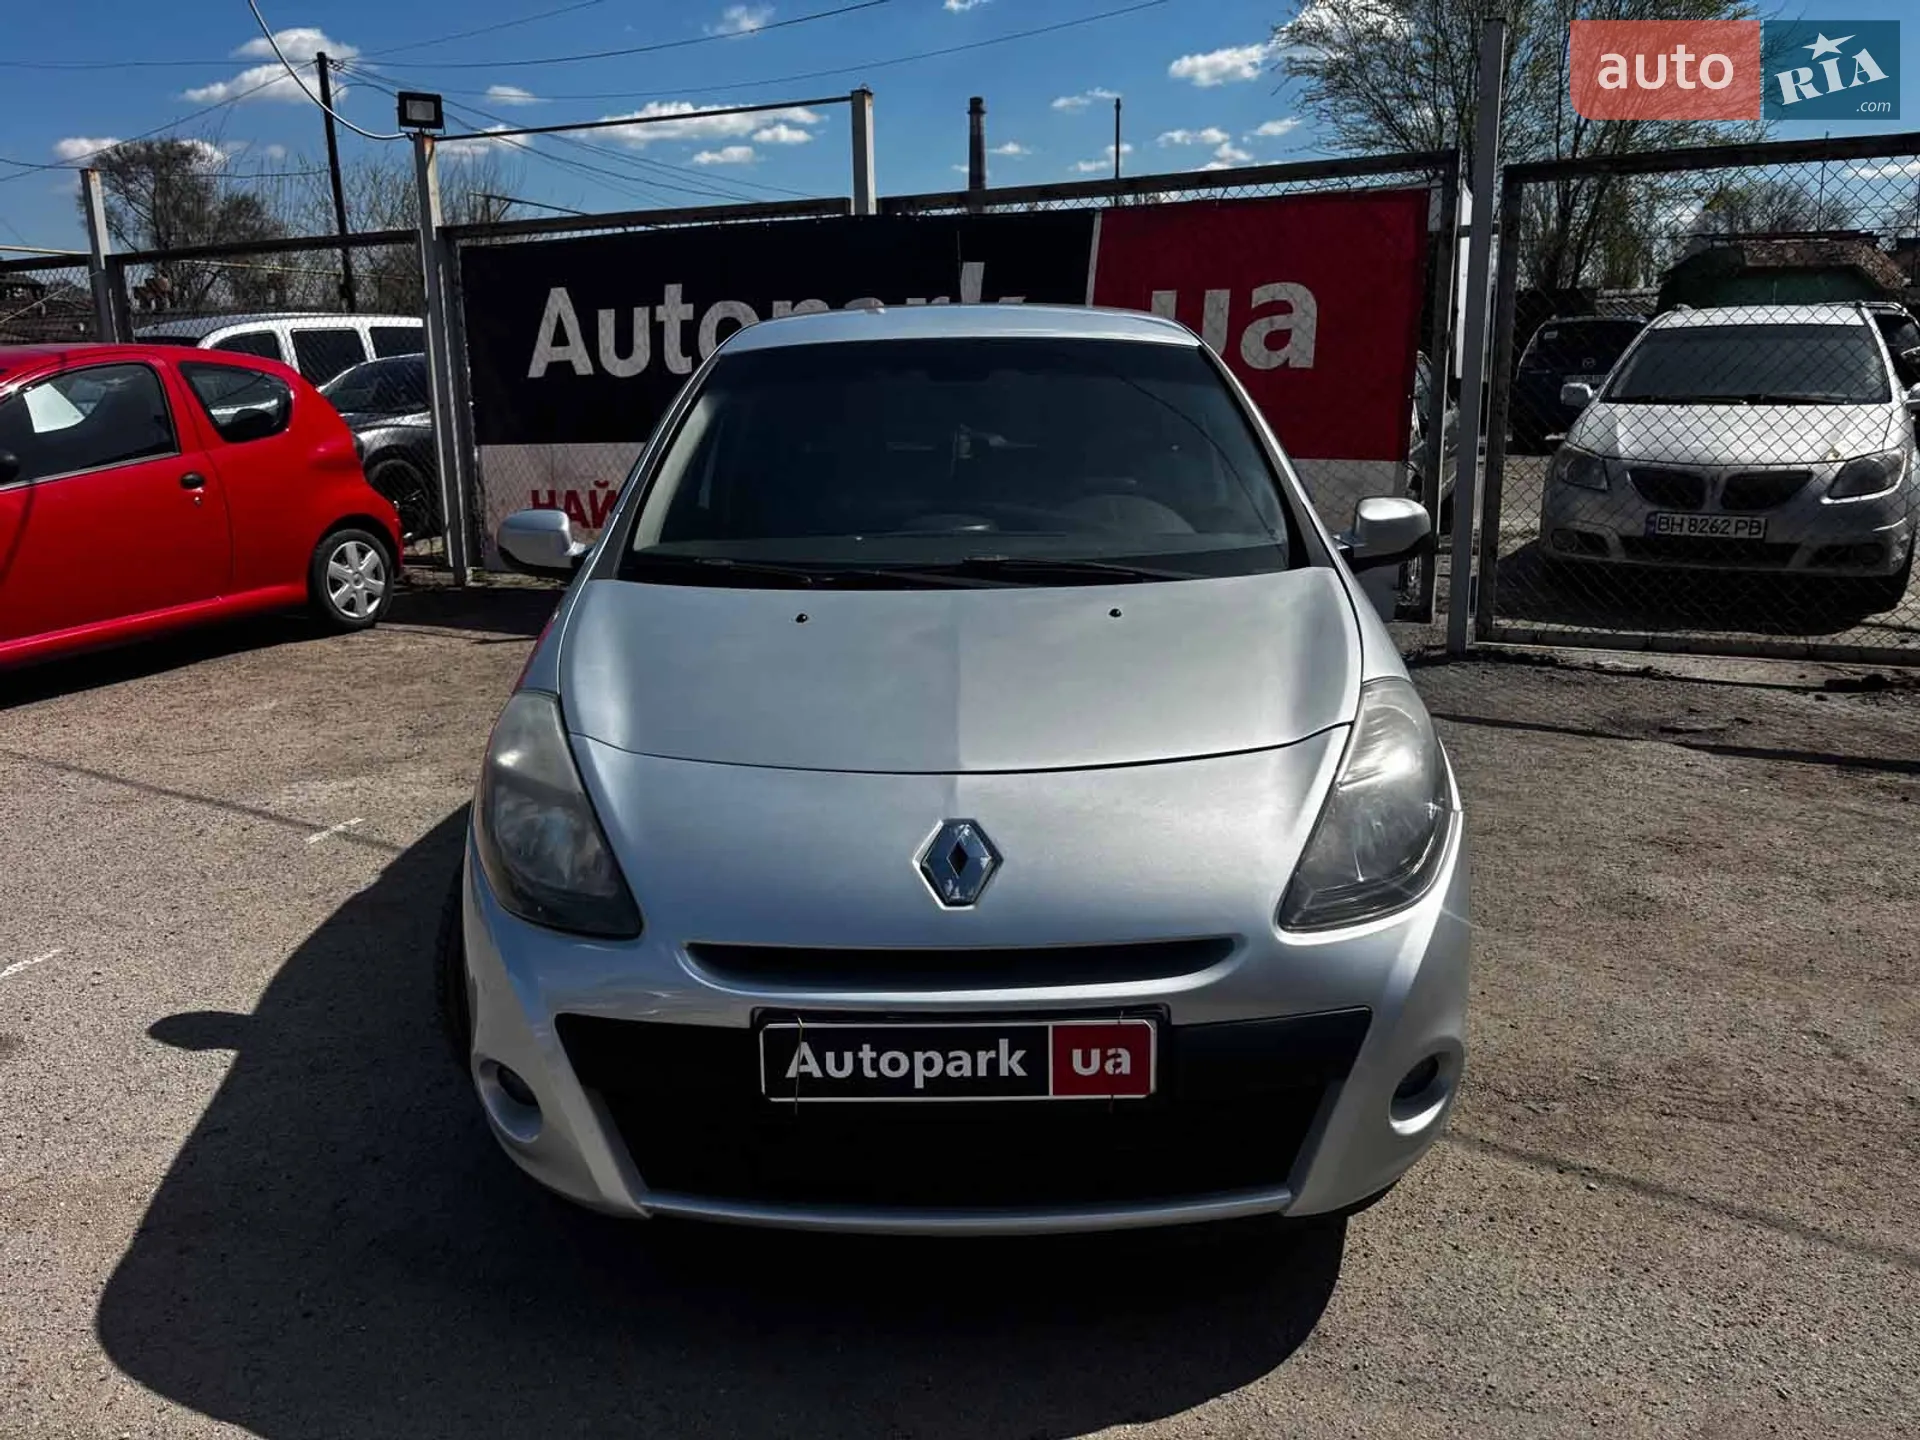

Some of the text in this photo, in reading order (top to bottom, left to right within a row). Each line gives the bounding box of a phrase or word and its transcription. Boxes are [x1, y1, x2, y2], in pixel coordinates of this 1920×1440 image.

[1688, 518, 1731, 535] 8262
[786, 1038, 1131, 1089] Autopark ua
